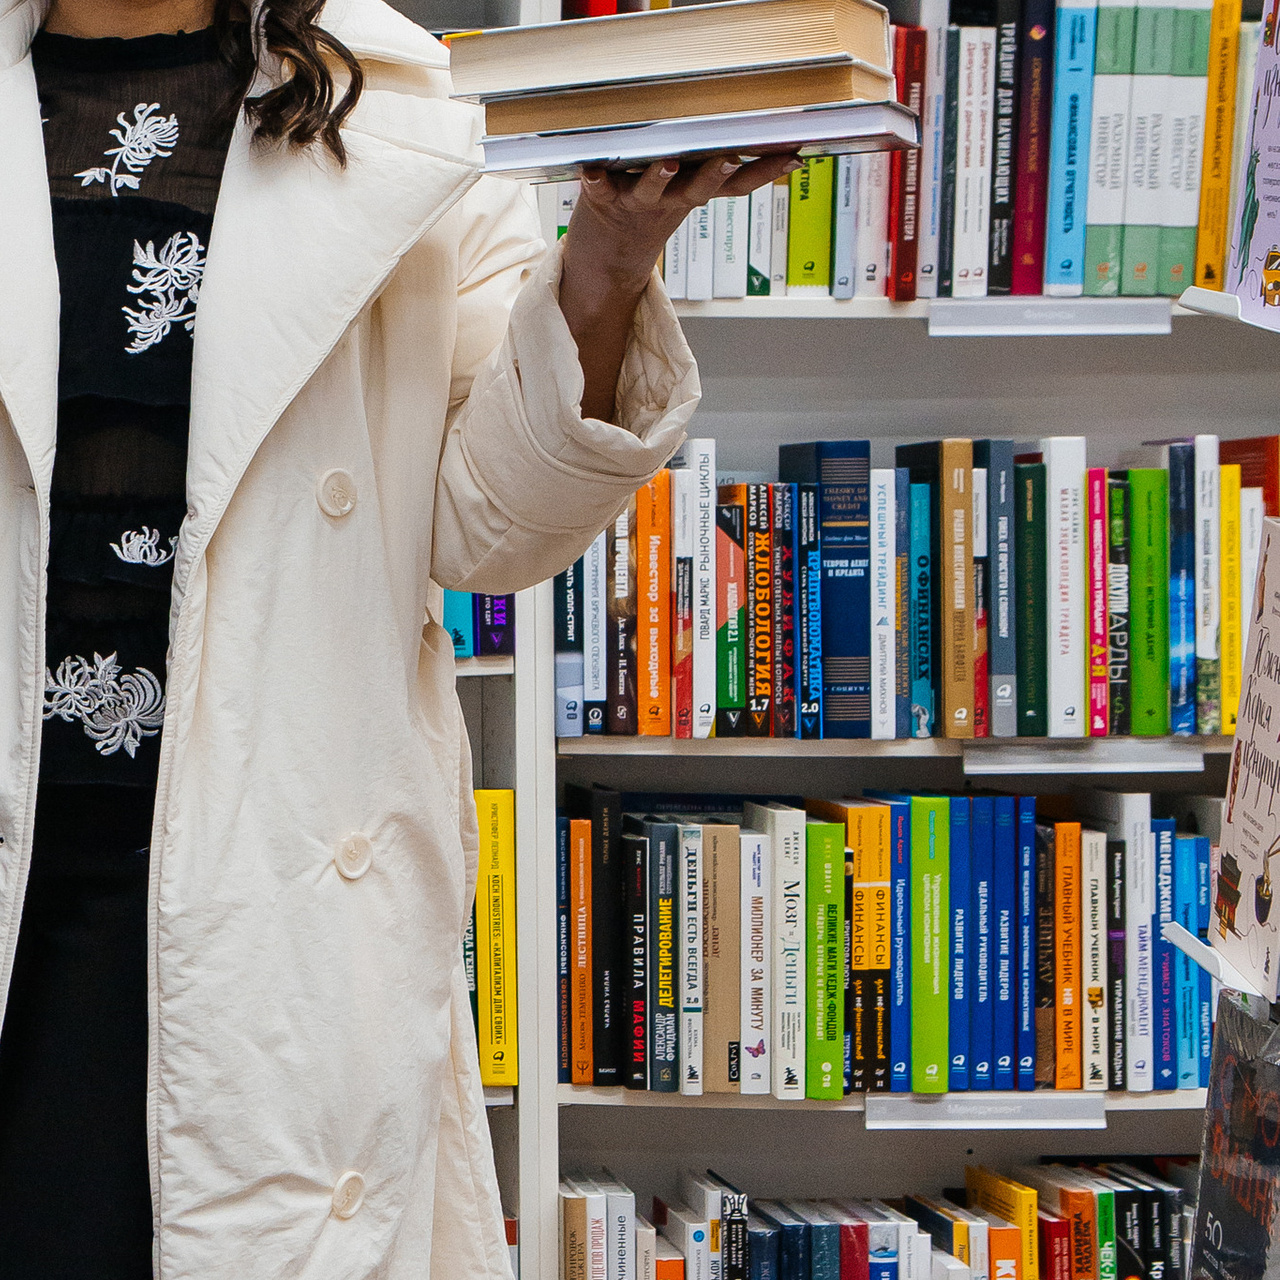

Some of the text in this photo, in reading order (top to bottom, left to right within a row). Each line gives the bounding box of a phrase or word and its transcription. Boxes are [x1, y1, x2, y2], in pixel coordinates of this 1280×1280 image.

[994, 22, 1015, 203] ТРЕЙДИНГ ДЛЯ НАЧИНАЮЩИХ
[1094, 116, 1110, 187] ИНВЕСТОР
[1110, 113, 1124, 190] РАЗУМНЫЙ
[1133, 116, 1148, 187] ИНВЕСТОР
[1147, 113, 1162, 190] РАЗУМНЫЙ
[1170, 117, 1185, 189] ИНВЕСТОР
[1185, 114, 1201, 192] РАЗУМНЫЙ
[749, 485, 757, 527] МАРКОВ
[759, 485, 768, 529] АЛЕКСЕЙ
[647, 535, 661, 699] Инвестор за выходные
[755, 532, 770, 696] ЖЛОБОЛОГИЯ
[876, 484, 889, 714] УСПЕШНЫЙ ТРЕЙДИНГ ДМИТРИЙ МИХНОВ
[749, 699, 769, 711] 1.7
[801, 703, 818, 713] 2.0
[492, 874, 502, 1045] KOCH INDUSTRIES: «КАПИТАЛИЗМ ДЛЯ СВОИХ»
[633, 914, 644, 1062] ПРАВИЛА МАФИИ
[659, 898, 674, 1007] ДЕЛЕГИРОВАНИЕ
[750, 896, 763, 1030] МИЛЛИОНЕР ЗА МИНУТУ
[655, 1013, 666, 1061] АЛЕКСАНДР
[665, 1013, 676, 1061] ФРИДМАН
[1201, 1001, 1210, 1057] ЛИДЕРСТВО
[1205, 1211, 1224, 1251] 50
